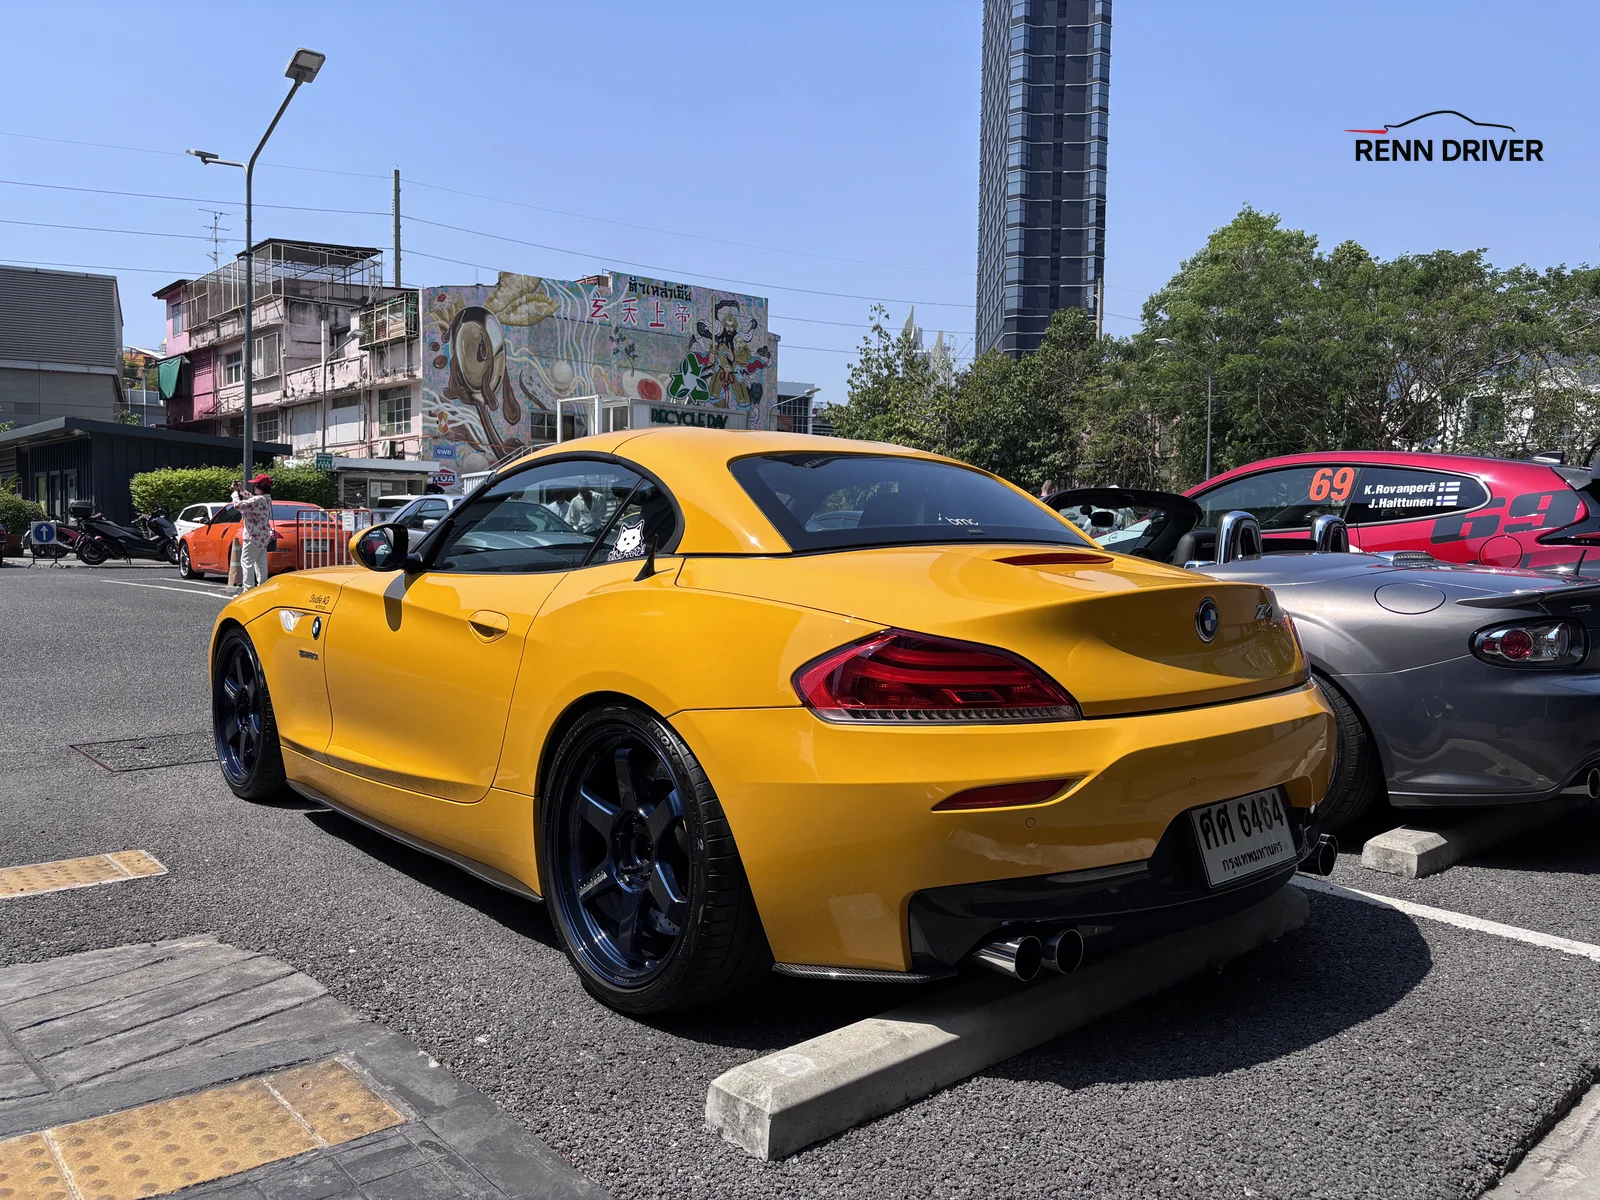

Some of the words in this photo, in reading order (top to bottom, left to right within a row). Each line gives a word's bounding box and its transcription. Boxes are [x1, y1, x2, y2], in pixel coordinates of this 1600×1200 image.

[590, 291, 691, 332] 玄天上帝
[651, 408, 706, 427] RECYCLE
[707, 413, 729, 429] DAY
[1309, 467, 1355, 501] 69
[1364, 482, 1436, 495] K.Rovanperä
[1368, 498, 1434, 509] J.Halttunen
[1430, 489, 1581, 544] 69
[1254, 603, 1273, 620] Z4
[1237, 792, 1284, 838] 6464
[1222, 841, 1283, 874] กรุงเทพมหานคร
